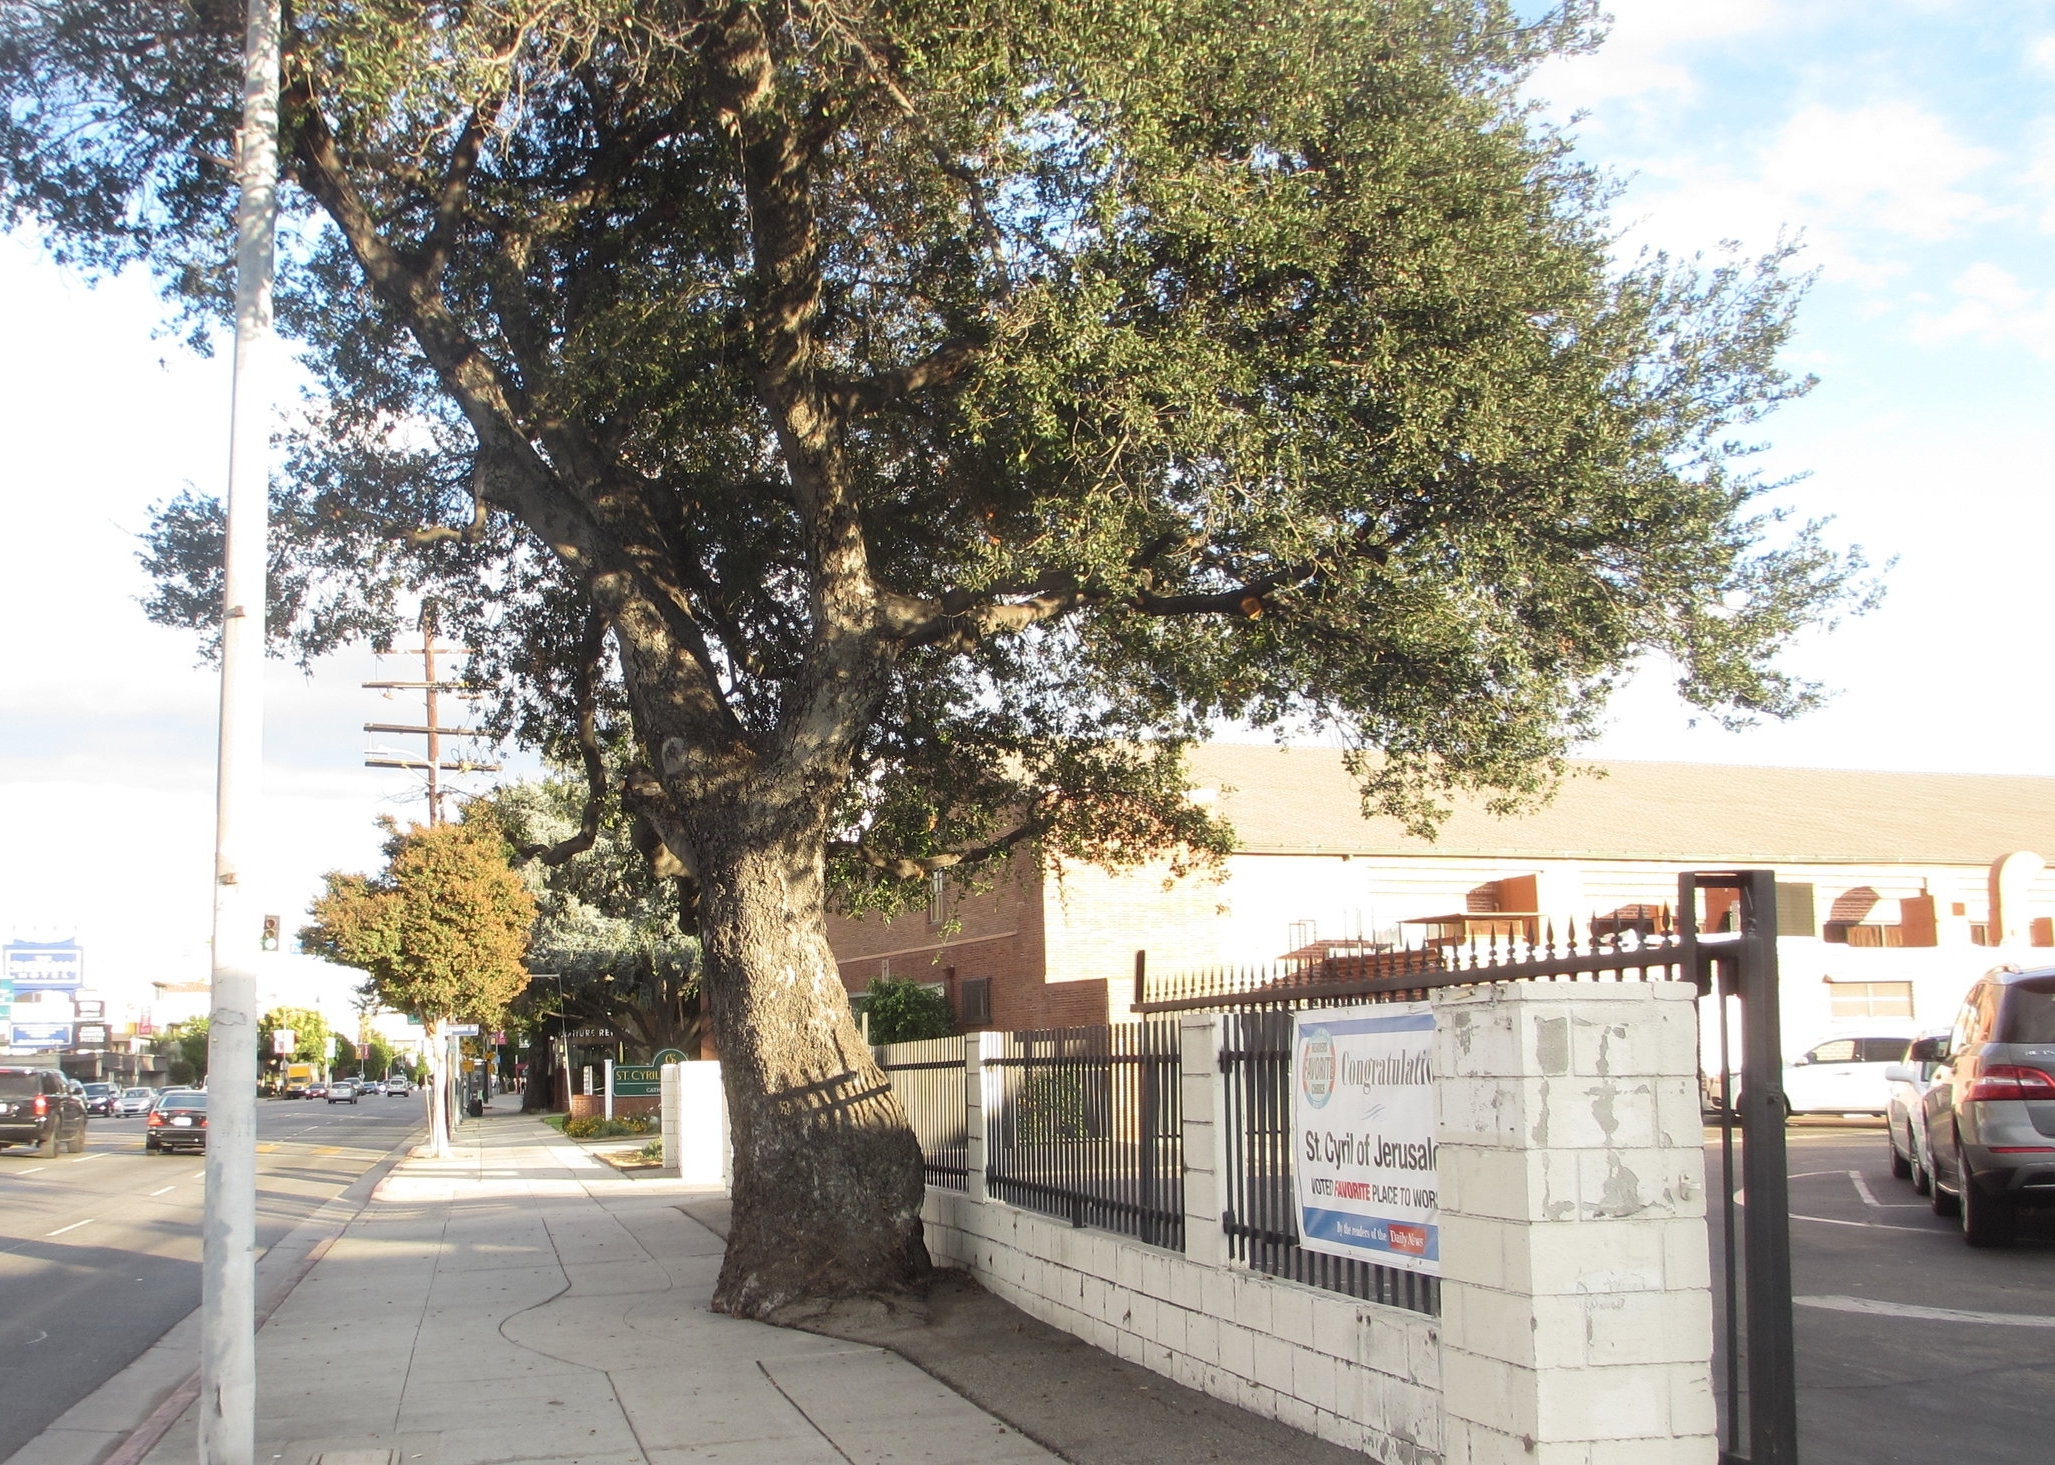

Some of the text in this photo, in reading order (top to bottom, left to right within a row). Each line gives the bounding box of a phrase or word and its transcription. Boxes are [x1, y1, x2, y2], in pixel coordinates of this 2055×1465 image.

[616, 1070, 661, 1081] ST. CYRIL
[1304, 1056, 1335, 1080] FAVORITE
[1342, 1049, 1434, 1095] Congratulatio
[1306, 1130, 1322, 1162] St.
[1324, 1131, 1354, 1171] Cyril
[1356, 1133, 1370, 1167] of
[1311, 1178, 1439, 1210] VOTED FAVORITE PLACE TO WOR
[1343, 1222, 1351, 1236] the
[1351, 1225, 1370, 1239] readers
[1370, 1227, 1377, 1240] of
[1377, 1227, 1387, 1242] the
[1389, 1229, 1424, 1247] Daily News
